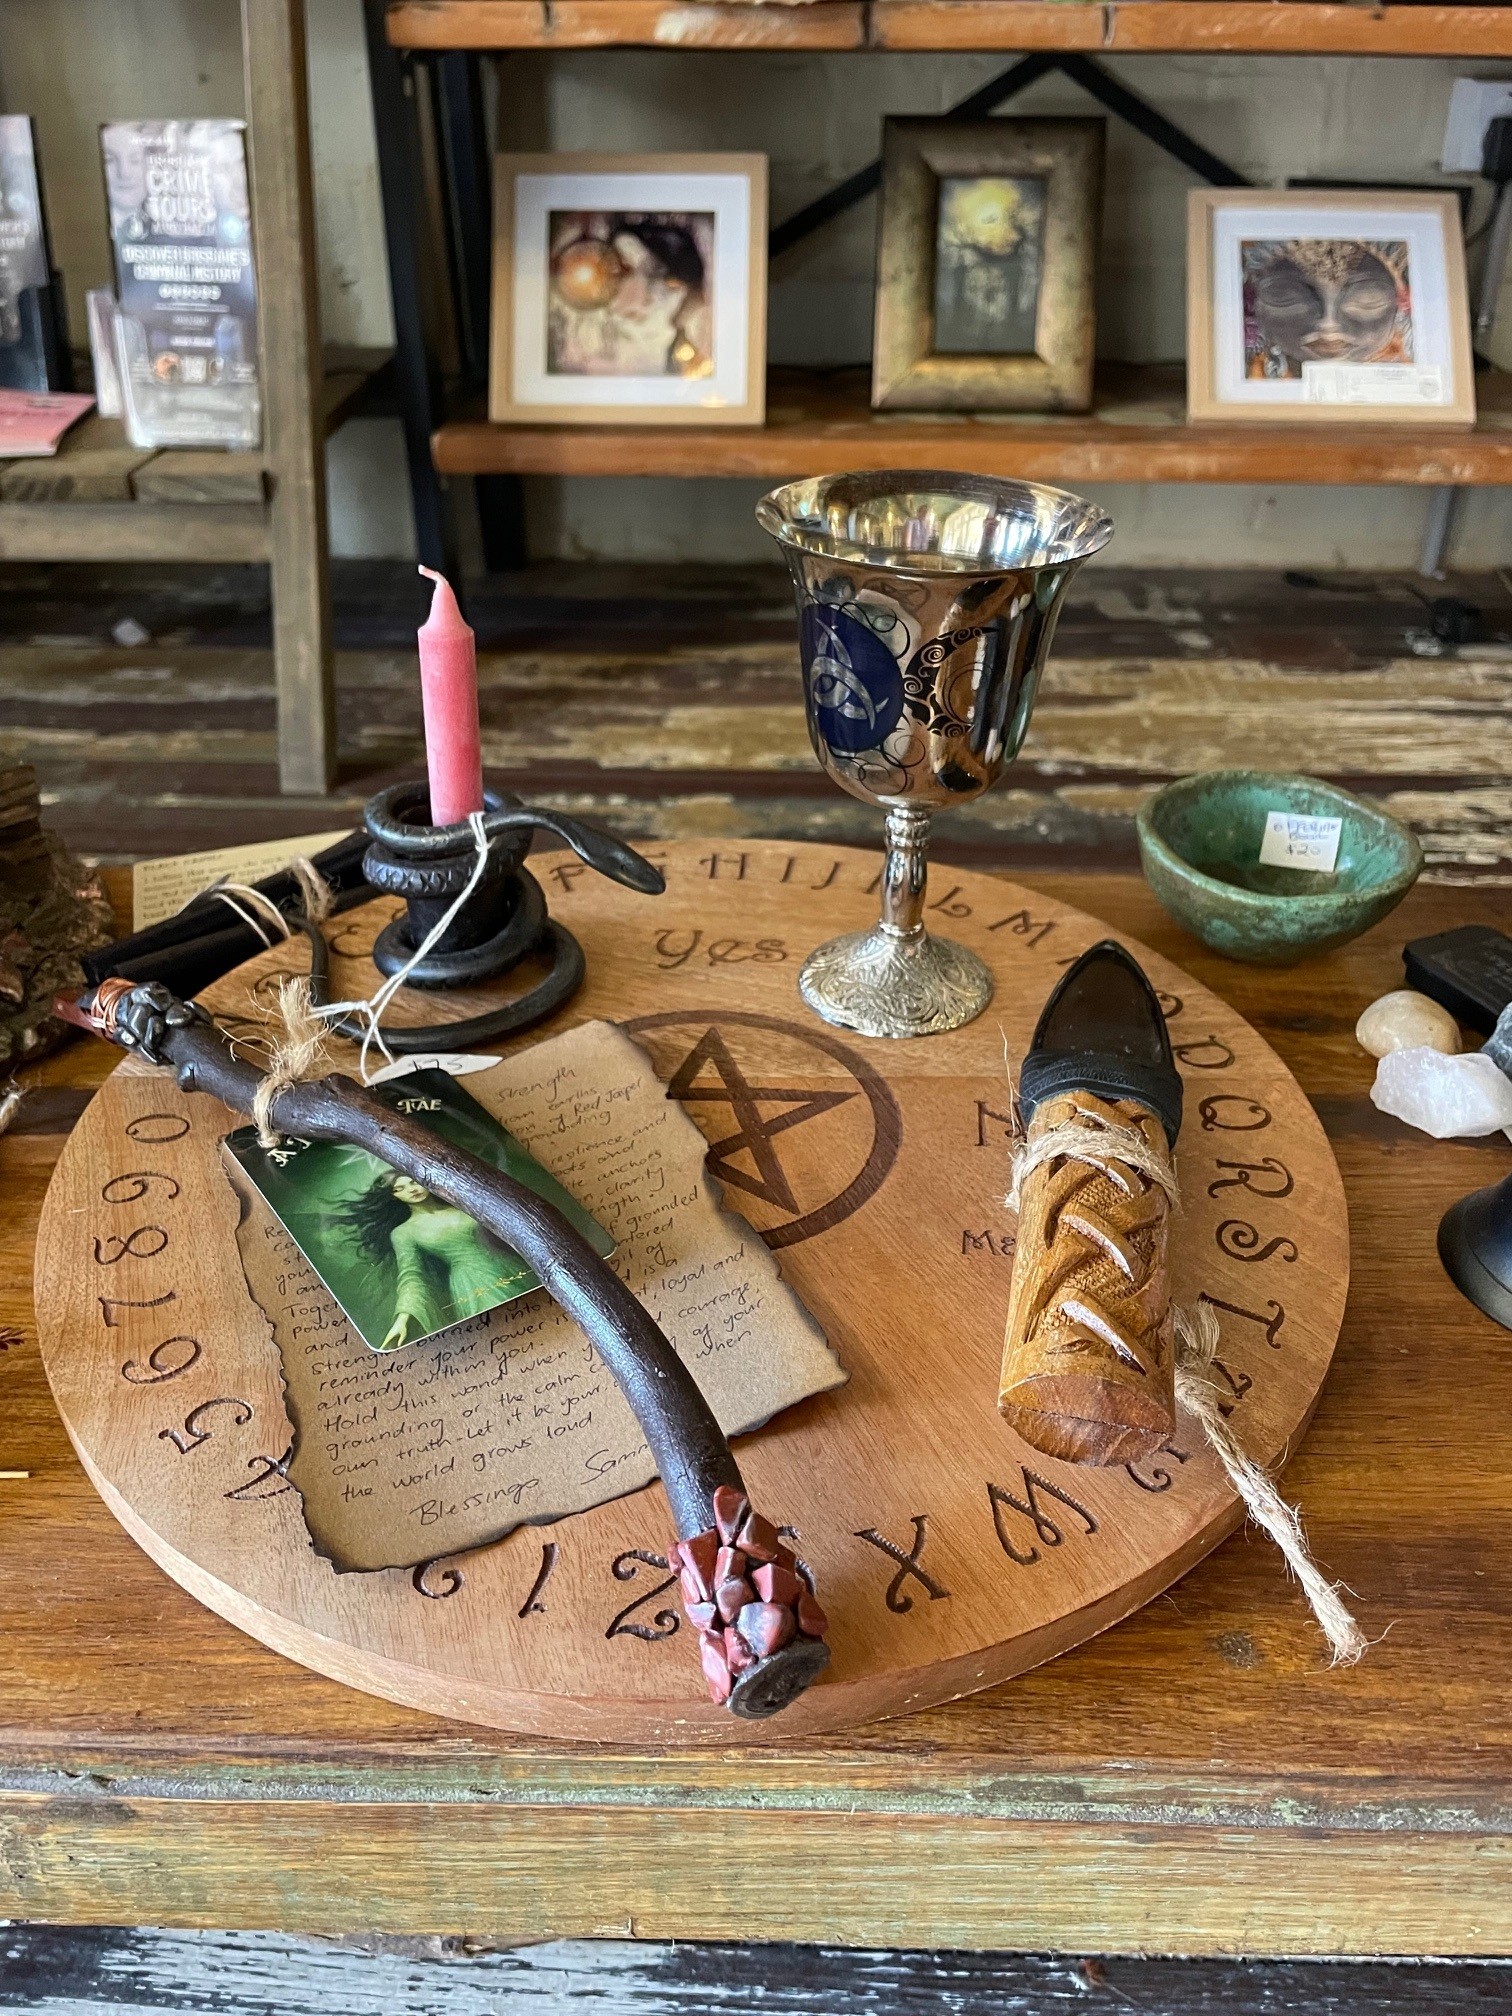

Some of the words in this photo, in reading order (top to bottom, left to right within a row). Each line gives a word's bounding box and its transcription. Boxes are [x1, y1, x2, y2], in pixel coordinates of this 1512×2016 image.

[699, 853, 748, 880] H
[810, 860, 841, 890] J
[927, 886, 972, 918] L
[986, 909, 1057, 948] M
[498, 1067, 576, 1103] Strength
[632, 1112, 667, 1137] and
[1199, 1094, 1272, 1132] Q
[597, 1140, 635, 1165] and
[1207, 1156, 1295, 1199] R
[626, 1185, 699, 1234] grounded
[92, 1225, 169, 1265] 8
[1215, 1218, 1299, 1263] S
[304, 1332, 349, 1355] and
[646, 1241, 667, 1266] of
[320, 1359, 417, 1392] reminder
[431, 1341, 478, 1374] your
[490, 1320, 544, 1354] power
[555, 1313, 569, 1326] is
[662, 1264, 705, 1293] loyal
[713, 1242, 745, 1271] and
[504, 1302, 541, 1323] into
[1197, 1291, 1286, 1350] T
[317, 1381, 404, 1412] already
[324, 1406, 378, 1432] Hold
[401, 1394, 437, 1413] this
[451, 1369, 507, 1399] wand
[520, 1351, 567, 1374] when
[326, 1418, 444, 1461] grounding
[462, 1404, 480, 1418] or
[499, 1392, 524, 1407] the
[535, 1374, 581, 1394] calm
[723, 1297, 764, 1332] your
[507, 1407, 521, 1426] it
[534, 1404, 554, 1418] be
[341, 1484, 374, 1503] the
[392, 1456, 455, 1489] world
[472, 1436, 533, 1472] grows
[547, 1411, 592, 1440] loud
[410, 1478, 540, 1526] Blessings
[853, 1513, 952, 1615] X
